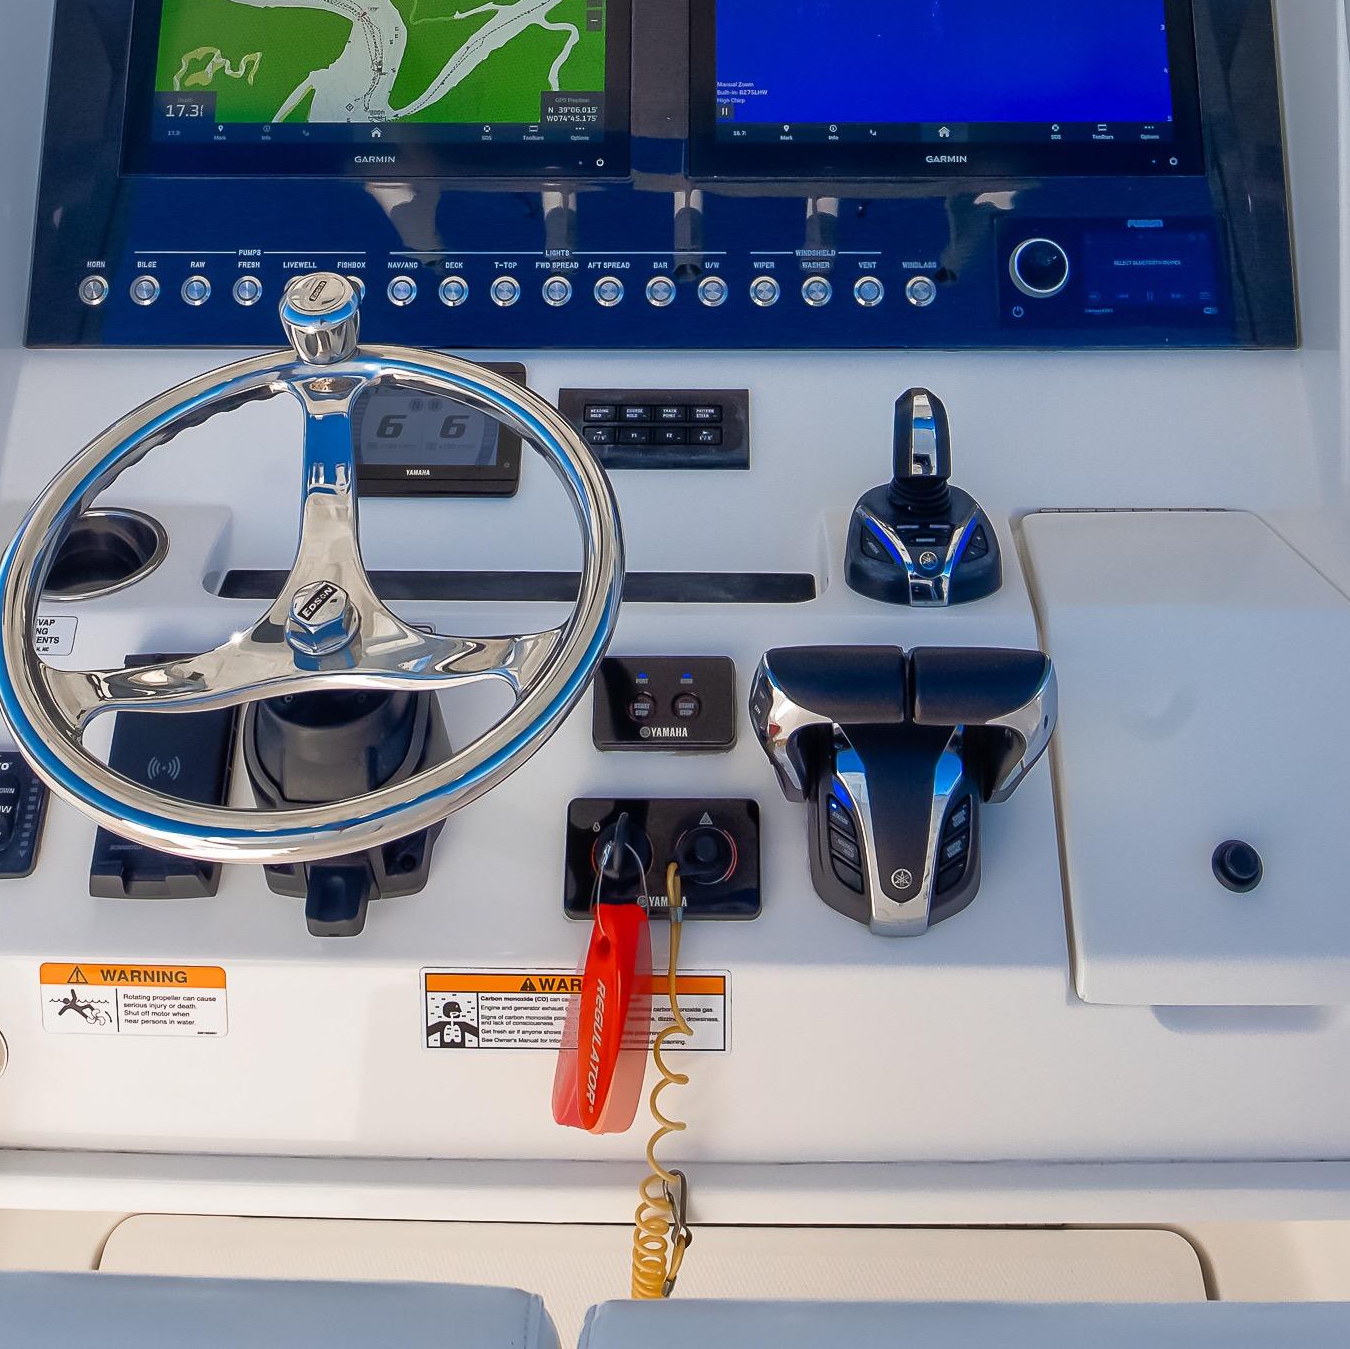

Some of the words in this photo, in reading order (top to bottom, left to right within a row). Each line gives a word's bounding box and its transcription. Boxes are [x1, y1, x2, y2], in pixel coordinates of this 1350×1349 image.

[165, 104, 199, 117] 17.3
[354, 155, 396, 163] GARMIN
[925, 155, 968, 163] GARMIN
[376, 415, 407, 438] 6
[439, 415, 470, 439] 6
[301, 587, 333, 618] EDSON
[651, 727, 688, 737] YAMAHA
[649, 896, 688, 907] YAMA
[100, 969, 188, 984] WARNING
[123, 993, 151, 1001] Rotating
[152, 994, 181, 1002] propeller
[587, 978, 606, 1106] REGULATOR
